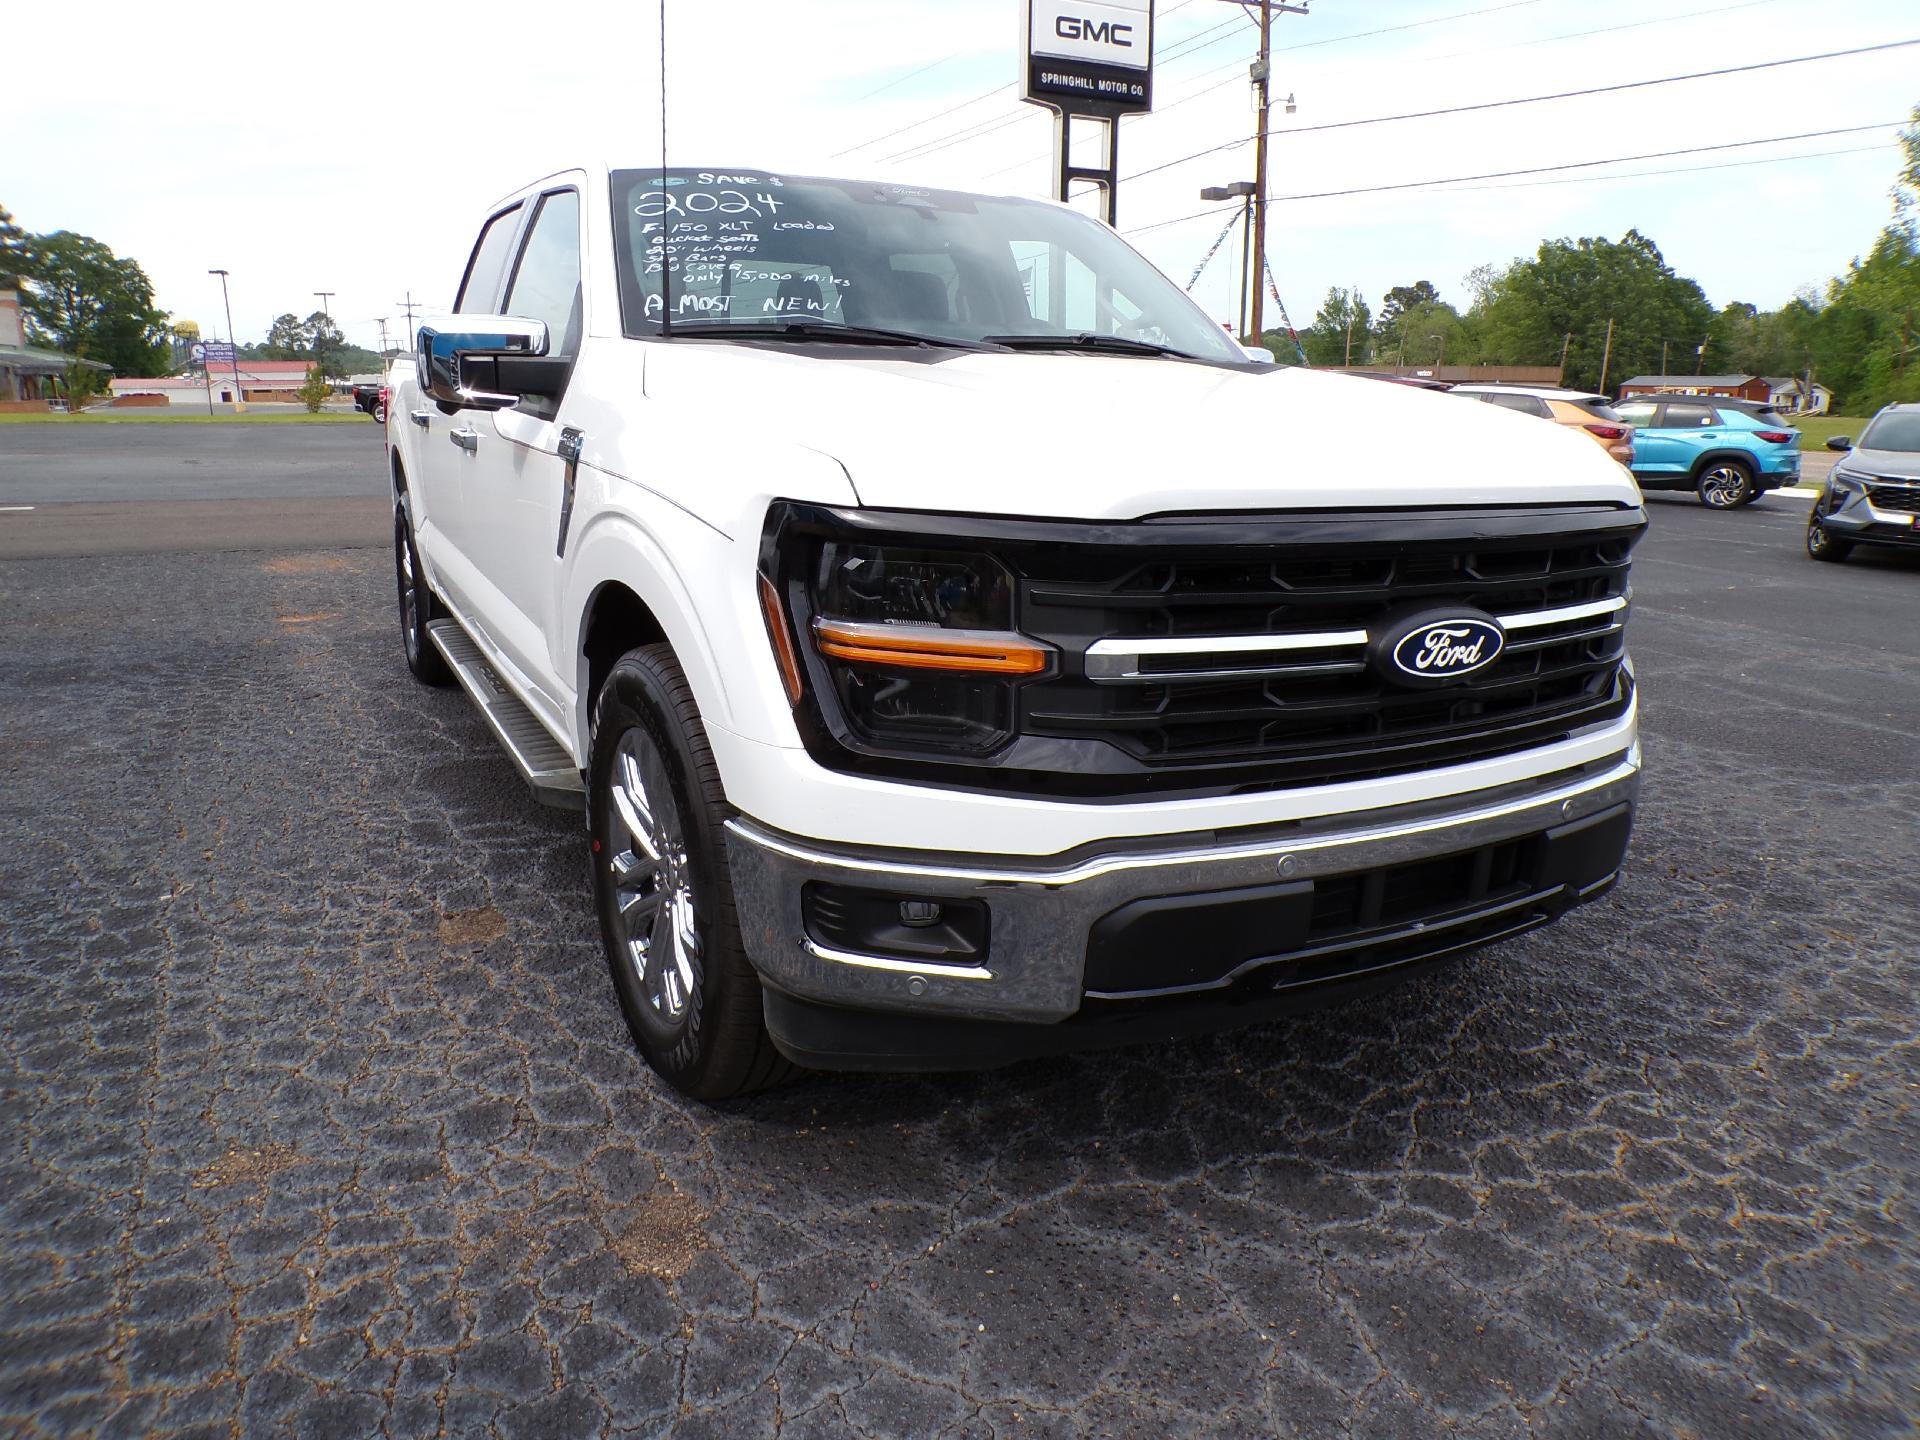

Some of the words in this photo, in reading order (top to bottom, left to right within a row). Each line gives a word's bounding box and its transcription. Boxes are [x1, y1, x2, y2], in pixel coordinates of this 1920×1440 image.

[1056, 16, 1132, 47] GMC
[1041, 72, 1094, 89] SPRINGHILL
[1098, 80, 1128, 95] MOTOR
[634, 190, 784, 218] 2024
[641, 222, 708, 234] F-150
[719, 221, 753, 231] XLT
[644, 293, 736, 317] AMOST
[1416, 628, 1485, 669] Ford
